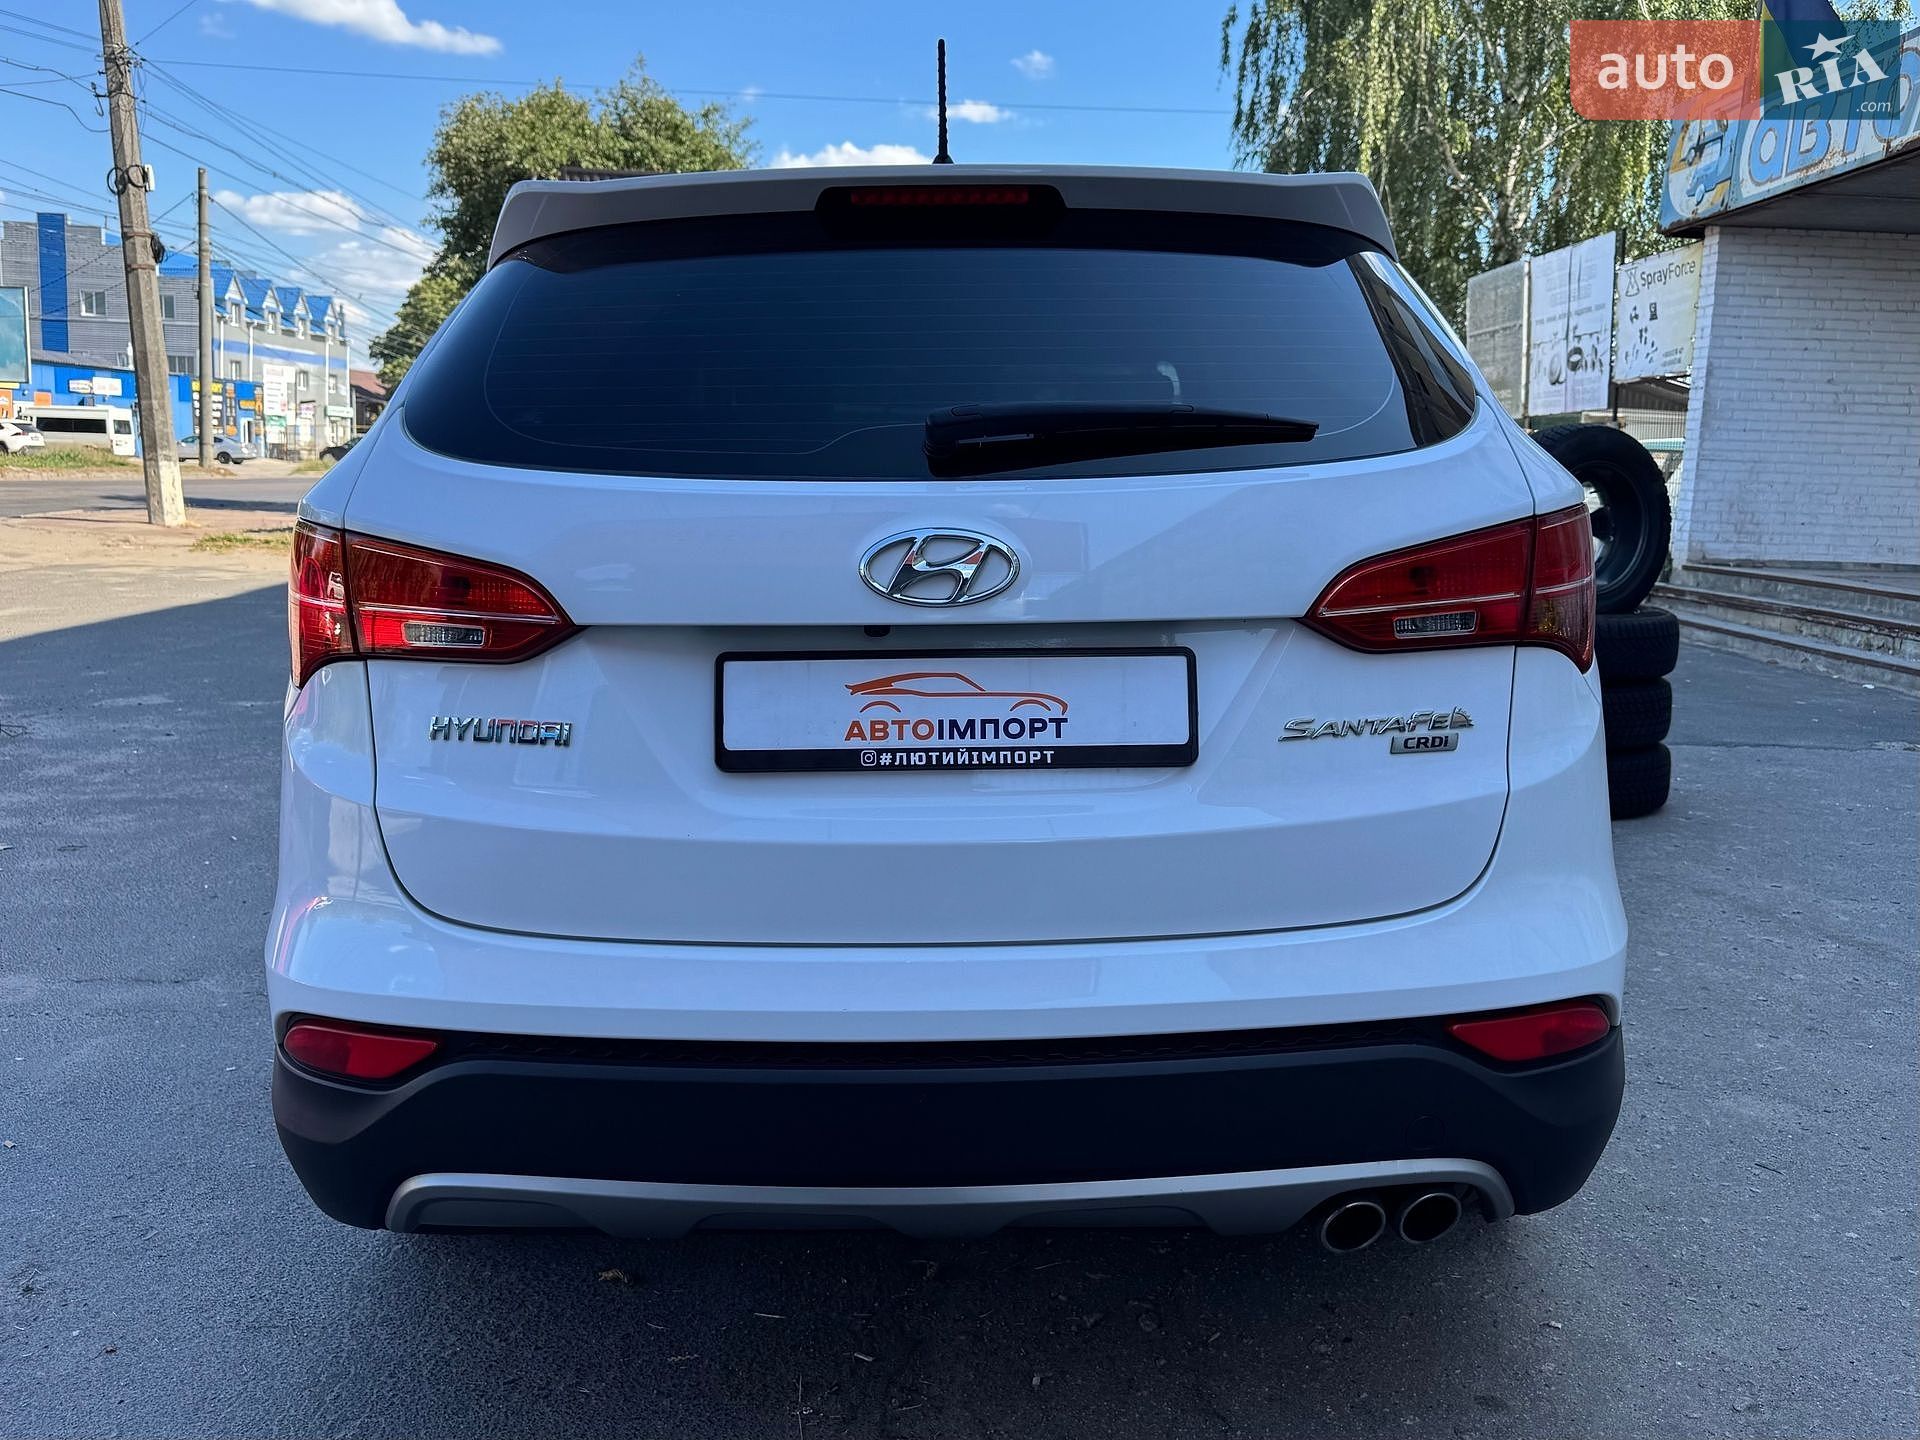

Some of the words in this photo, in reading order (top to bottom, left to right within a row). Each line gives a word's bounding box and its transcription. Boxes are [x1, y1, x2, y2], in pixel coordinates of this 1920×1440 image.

[1640, 259, 1696, 289] SprayForce
[430, 716, 573, 747] HYUNDAI
[844, 717, 1069, 741] АВТОІМПОРТ
[1403, 735, 1449, 750] CRDI
